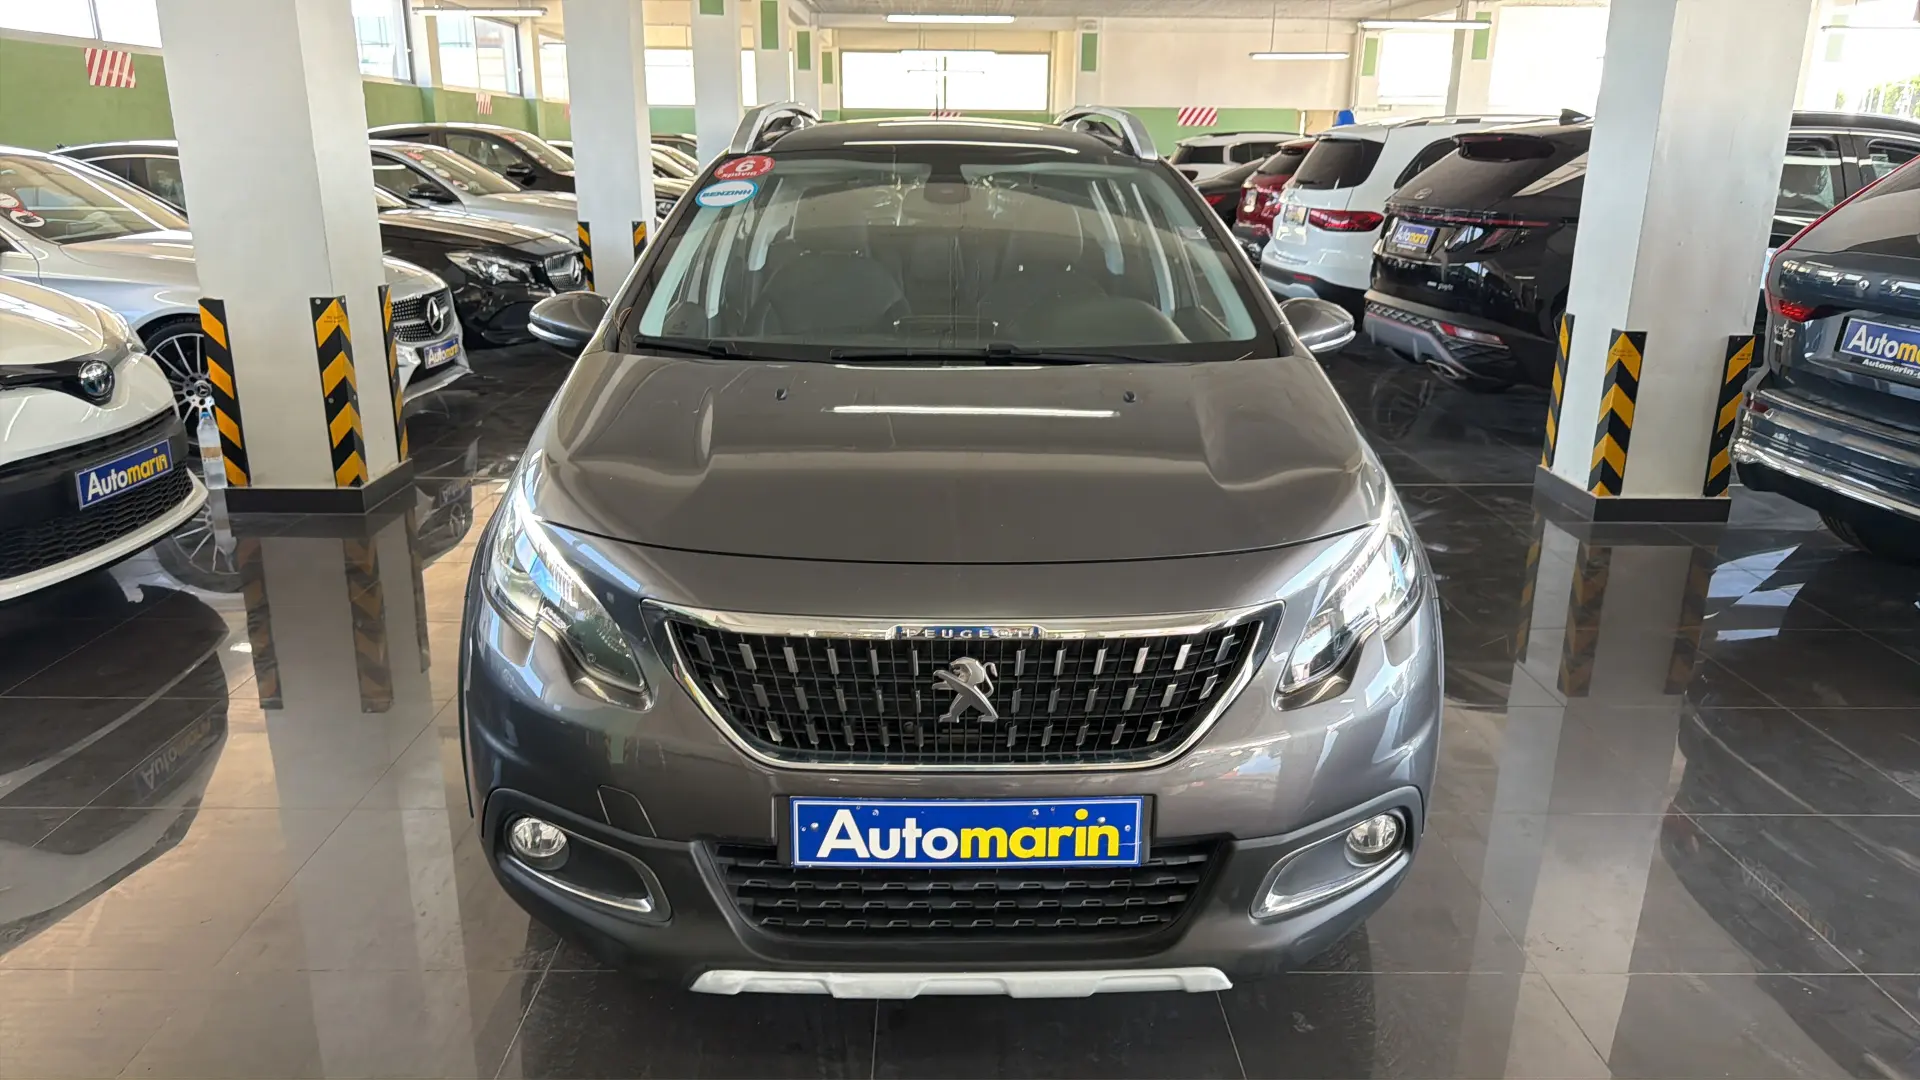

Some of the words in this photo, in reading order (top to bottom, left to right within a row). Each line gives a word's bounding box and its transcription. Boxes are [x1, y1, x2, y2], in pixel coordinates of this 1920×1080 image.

[735, 159, 756, 173] 6
[87, 448, 168, 501] Automarin
[906, 628, 1024, 639] PEUGEOT
[816, 809, 1120, 860] Automarin
